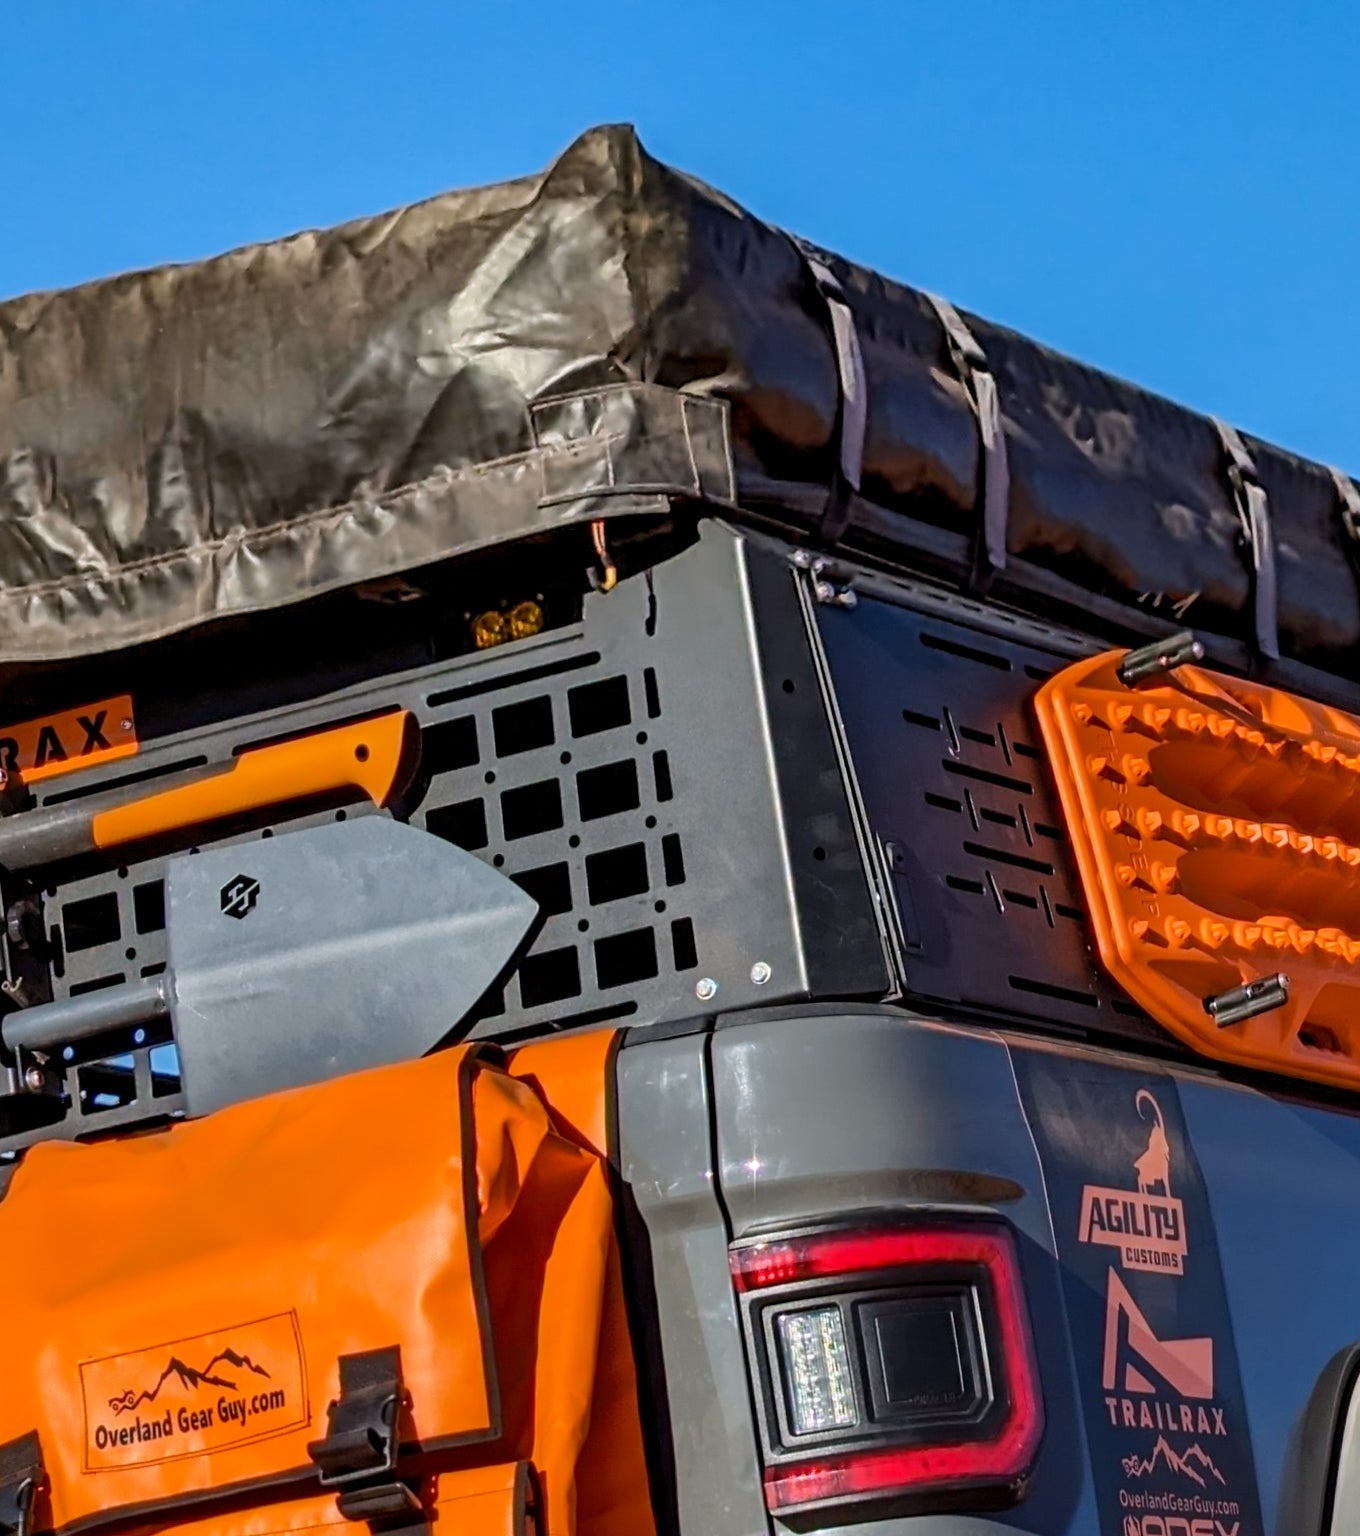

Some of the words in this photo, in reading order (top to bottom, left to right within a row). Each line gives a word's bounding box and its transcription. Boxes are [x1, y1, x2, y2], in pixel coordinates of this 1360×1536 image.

[1125, 1246, 1179, 1268] CUSTOMS
[95, 1409, 174, 1450] Overland
[177, 1406, 214, 1434] Gear
[217, 1388, 286, 1427] Guy.com
[1104, 1396, 1228, 1436] TRAILRAX
[1119, 1488, 1240, 1519] OverlandGearGuy.com
